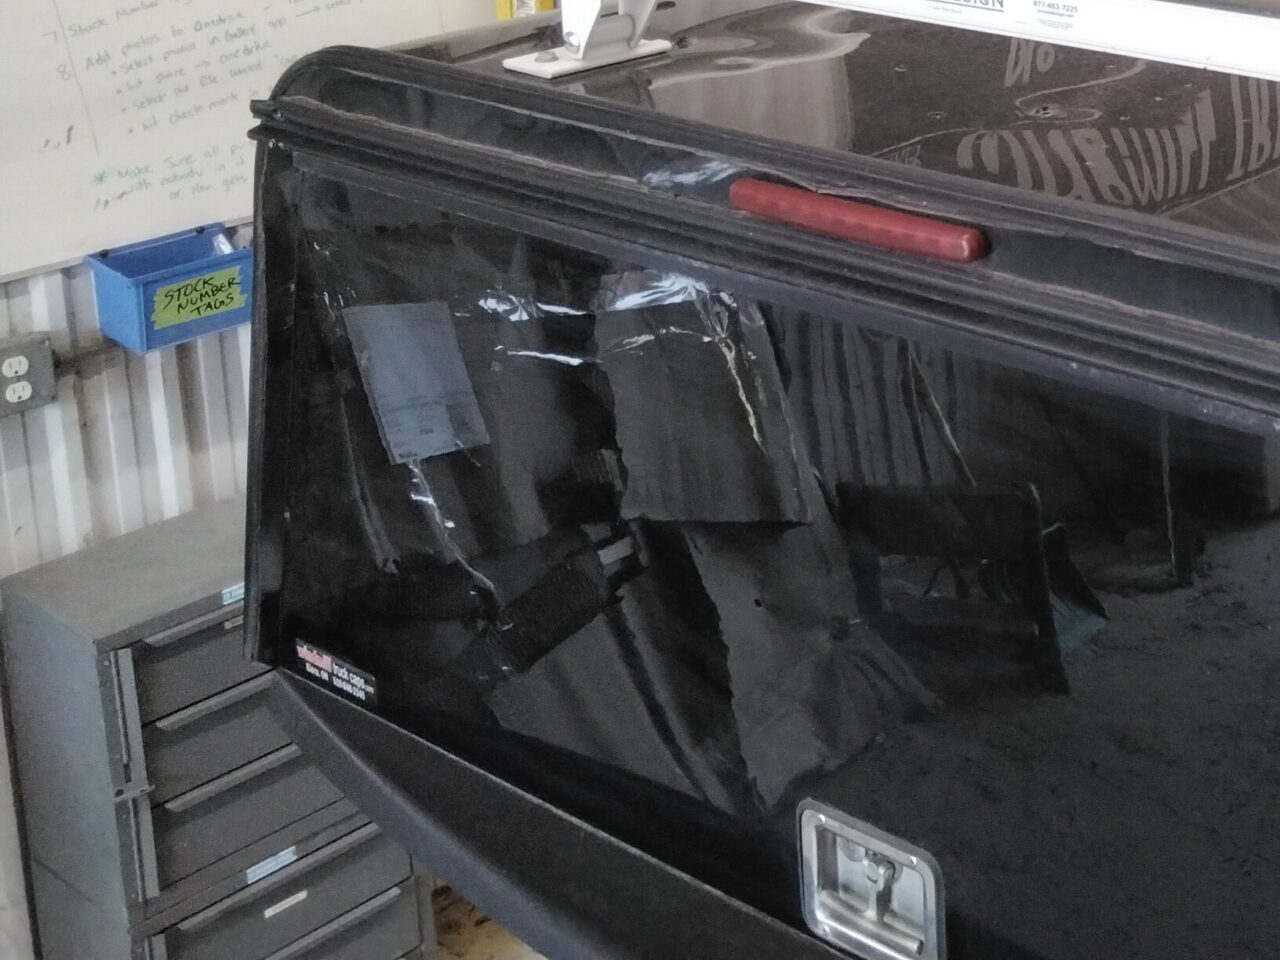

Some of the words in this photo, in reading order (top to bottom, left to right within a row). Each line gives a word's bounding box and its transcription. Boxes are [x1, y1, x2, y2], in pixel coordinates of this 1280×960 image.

[163, 276, 216, 310] STOCK
[177, 276, 242, 315] NUMBER
[190, 292, 234, 317] TAGS
